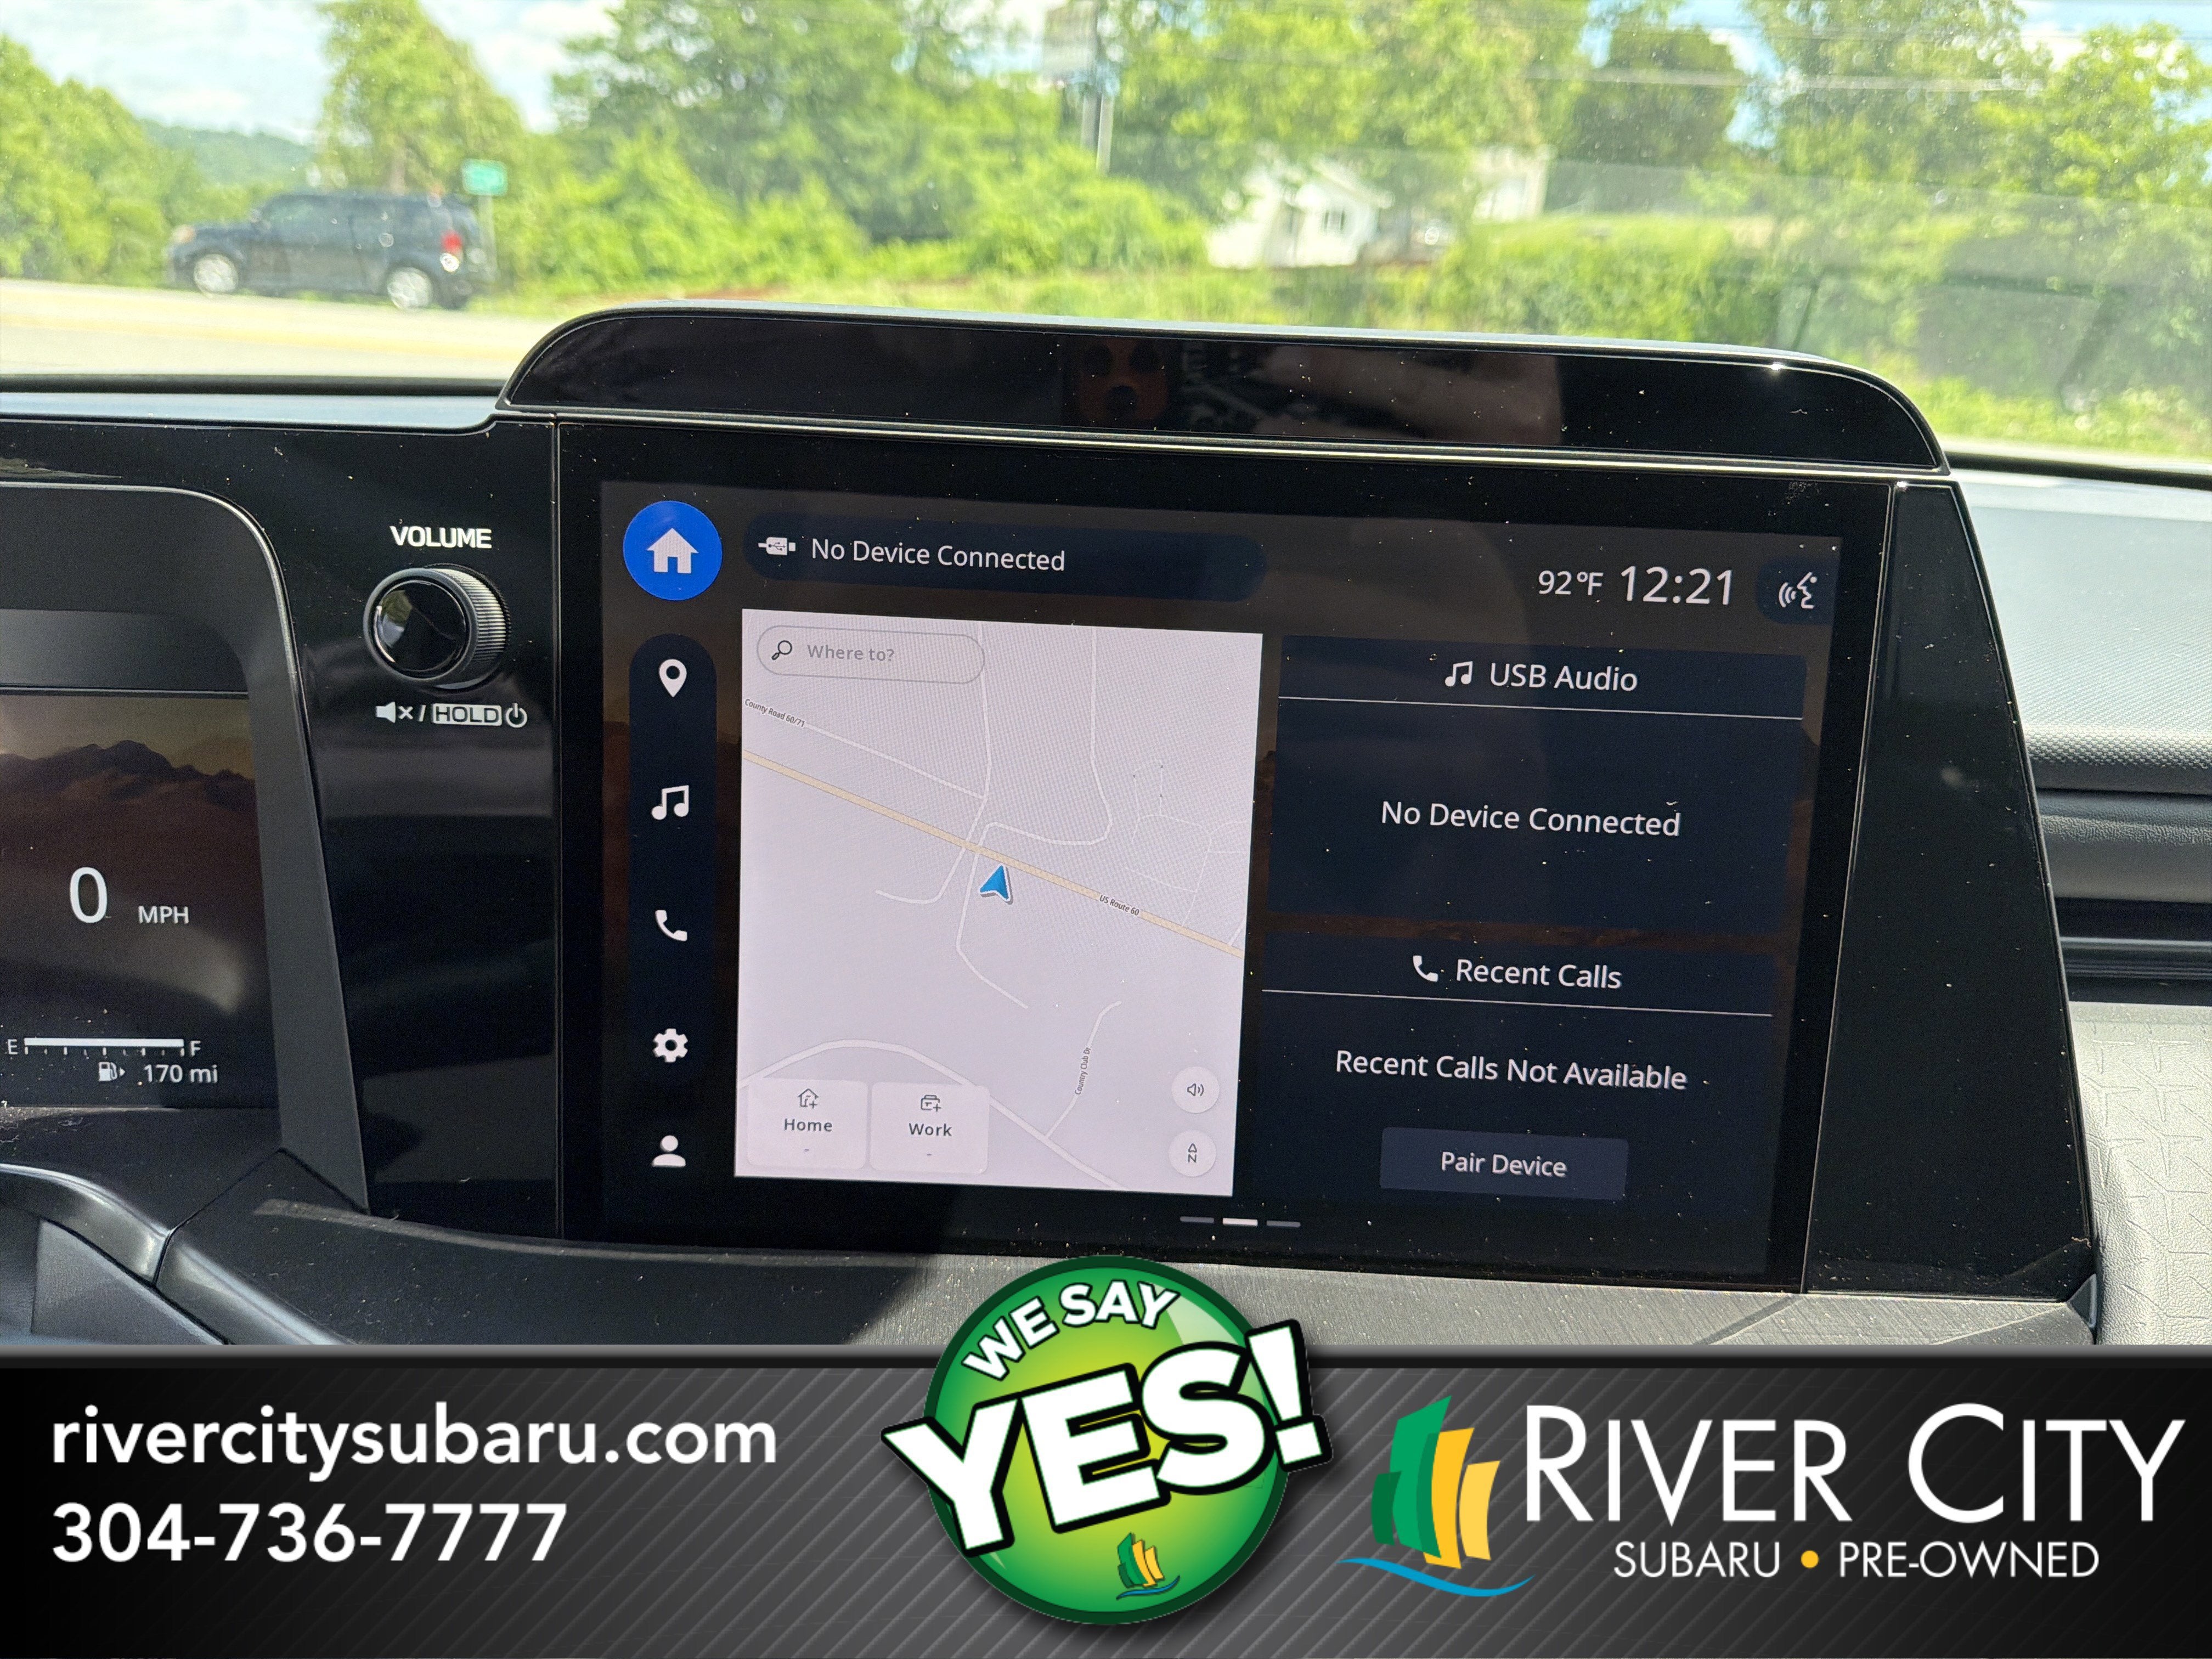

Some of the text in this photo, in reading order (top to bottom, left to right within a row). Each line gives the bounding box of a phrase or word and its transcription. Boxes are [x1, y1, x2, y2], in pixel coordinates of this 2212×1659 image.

[390, 526, 492, 549] VOLUME
[812, 538, 1065, 571] No Device Connected
[1621, 566, 1732, 605] 12:21
[806, 644, 895, 662] Where to?
[1490, 663, 1638, 691] USB Audio
[436, 705, 500, 724] HOLD
[744, 698, 805, 727] County Road 60/71
[1381, 801, 1680, 837] No Device Connected
[70, 867, 189, 924] 0 MPH
[1099, 894, 1139, 916] US Route 60
[1457, 959, 1621, 989] Recent Calls
[7, 1039, 201, 1056] E F
[144, 1064, 218, 1083] 170 mi
[1075, 1046, 1091, 1095] Country Club Dr
[1336, 1050, 1687, 1090] Recent Calls Not Available
[784, 1118, 833, 1132] Home
[909, 1122, 952, 1137] Work
[1441, 1152, 1567, 1177] Pair Device
